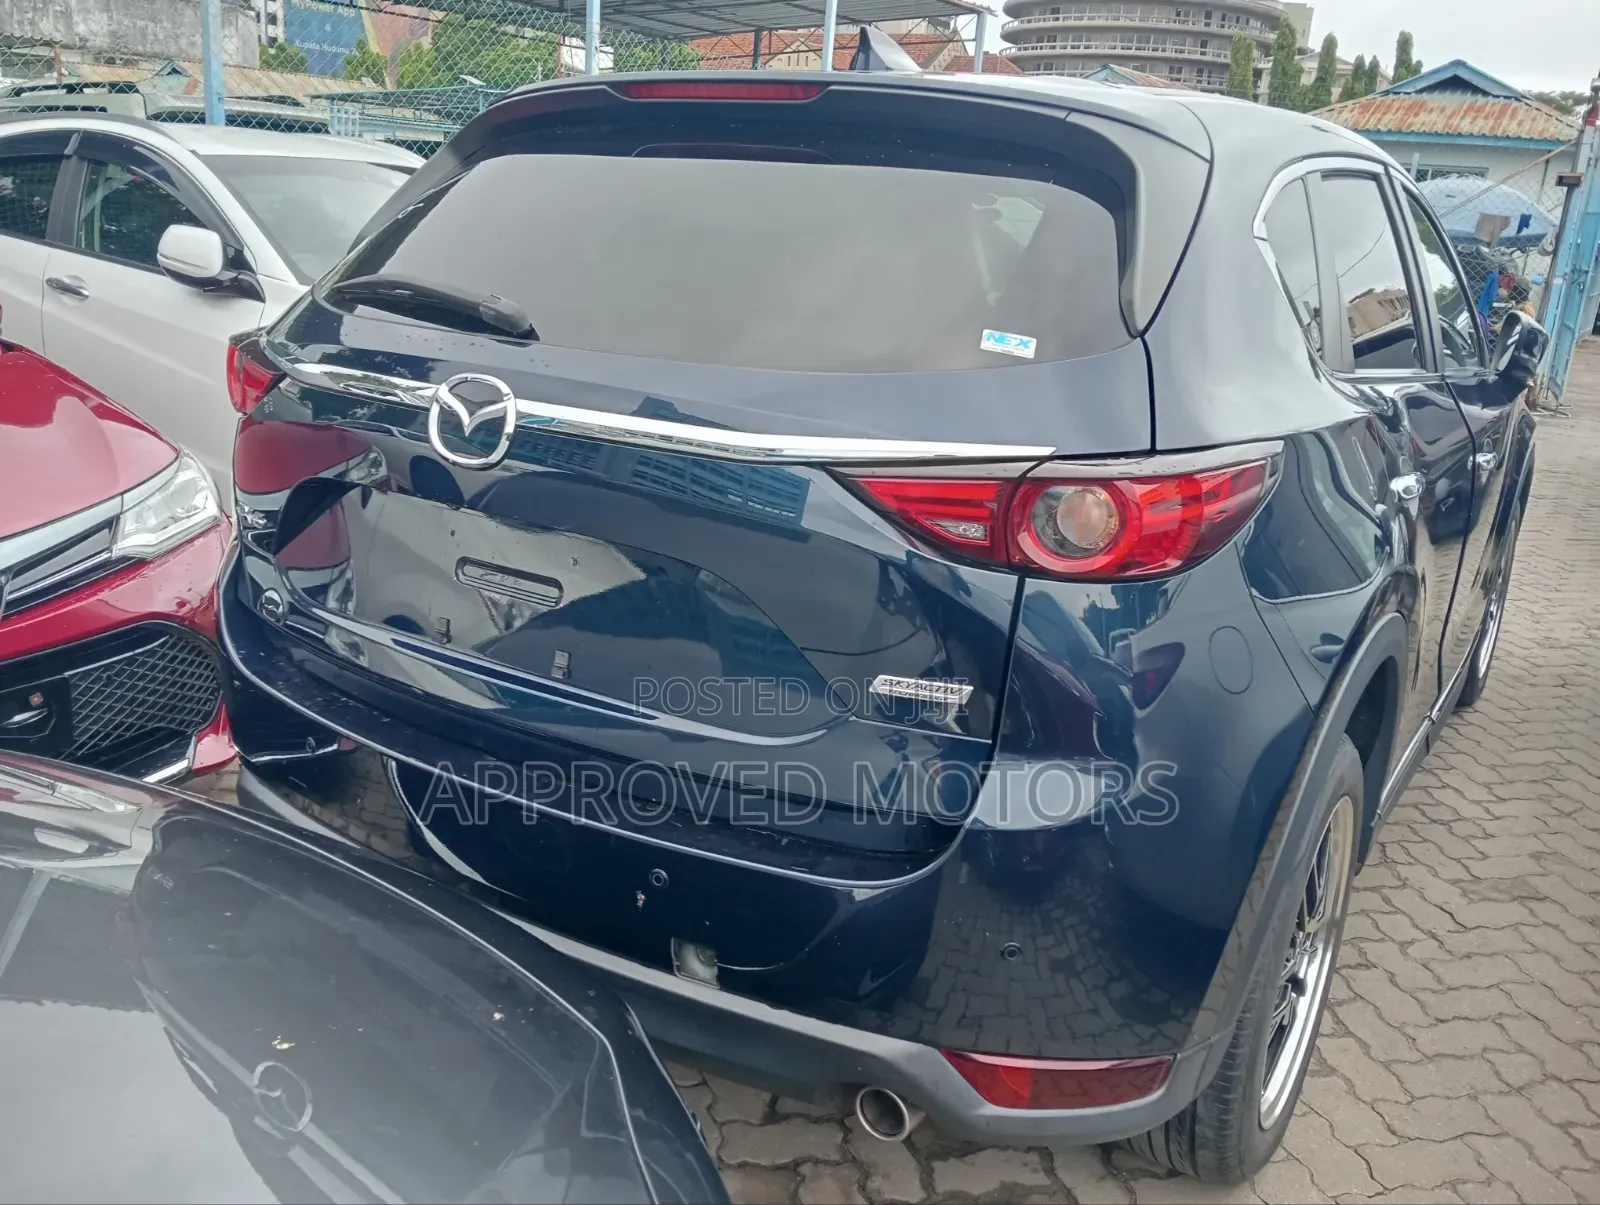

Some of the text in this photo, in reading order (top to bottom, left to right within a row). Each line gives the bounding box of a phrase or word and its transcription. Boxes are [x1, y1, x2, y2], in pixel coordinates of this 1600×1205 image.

[337, 5, 356, 17] App
[295, 40, 320, 50] Kupata
[985, 331, 1032, 349] NEX
[881, 678, 962, 694] SKYACTIV
